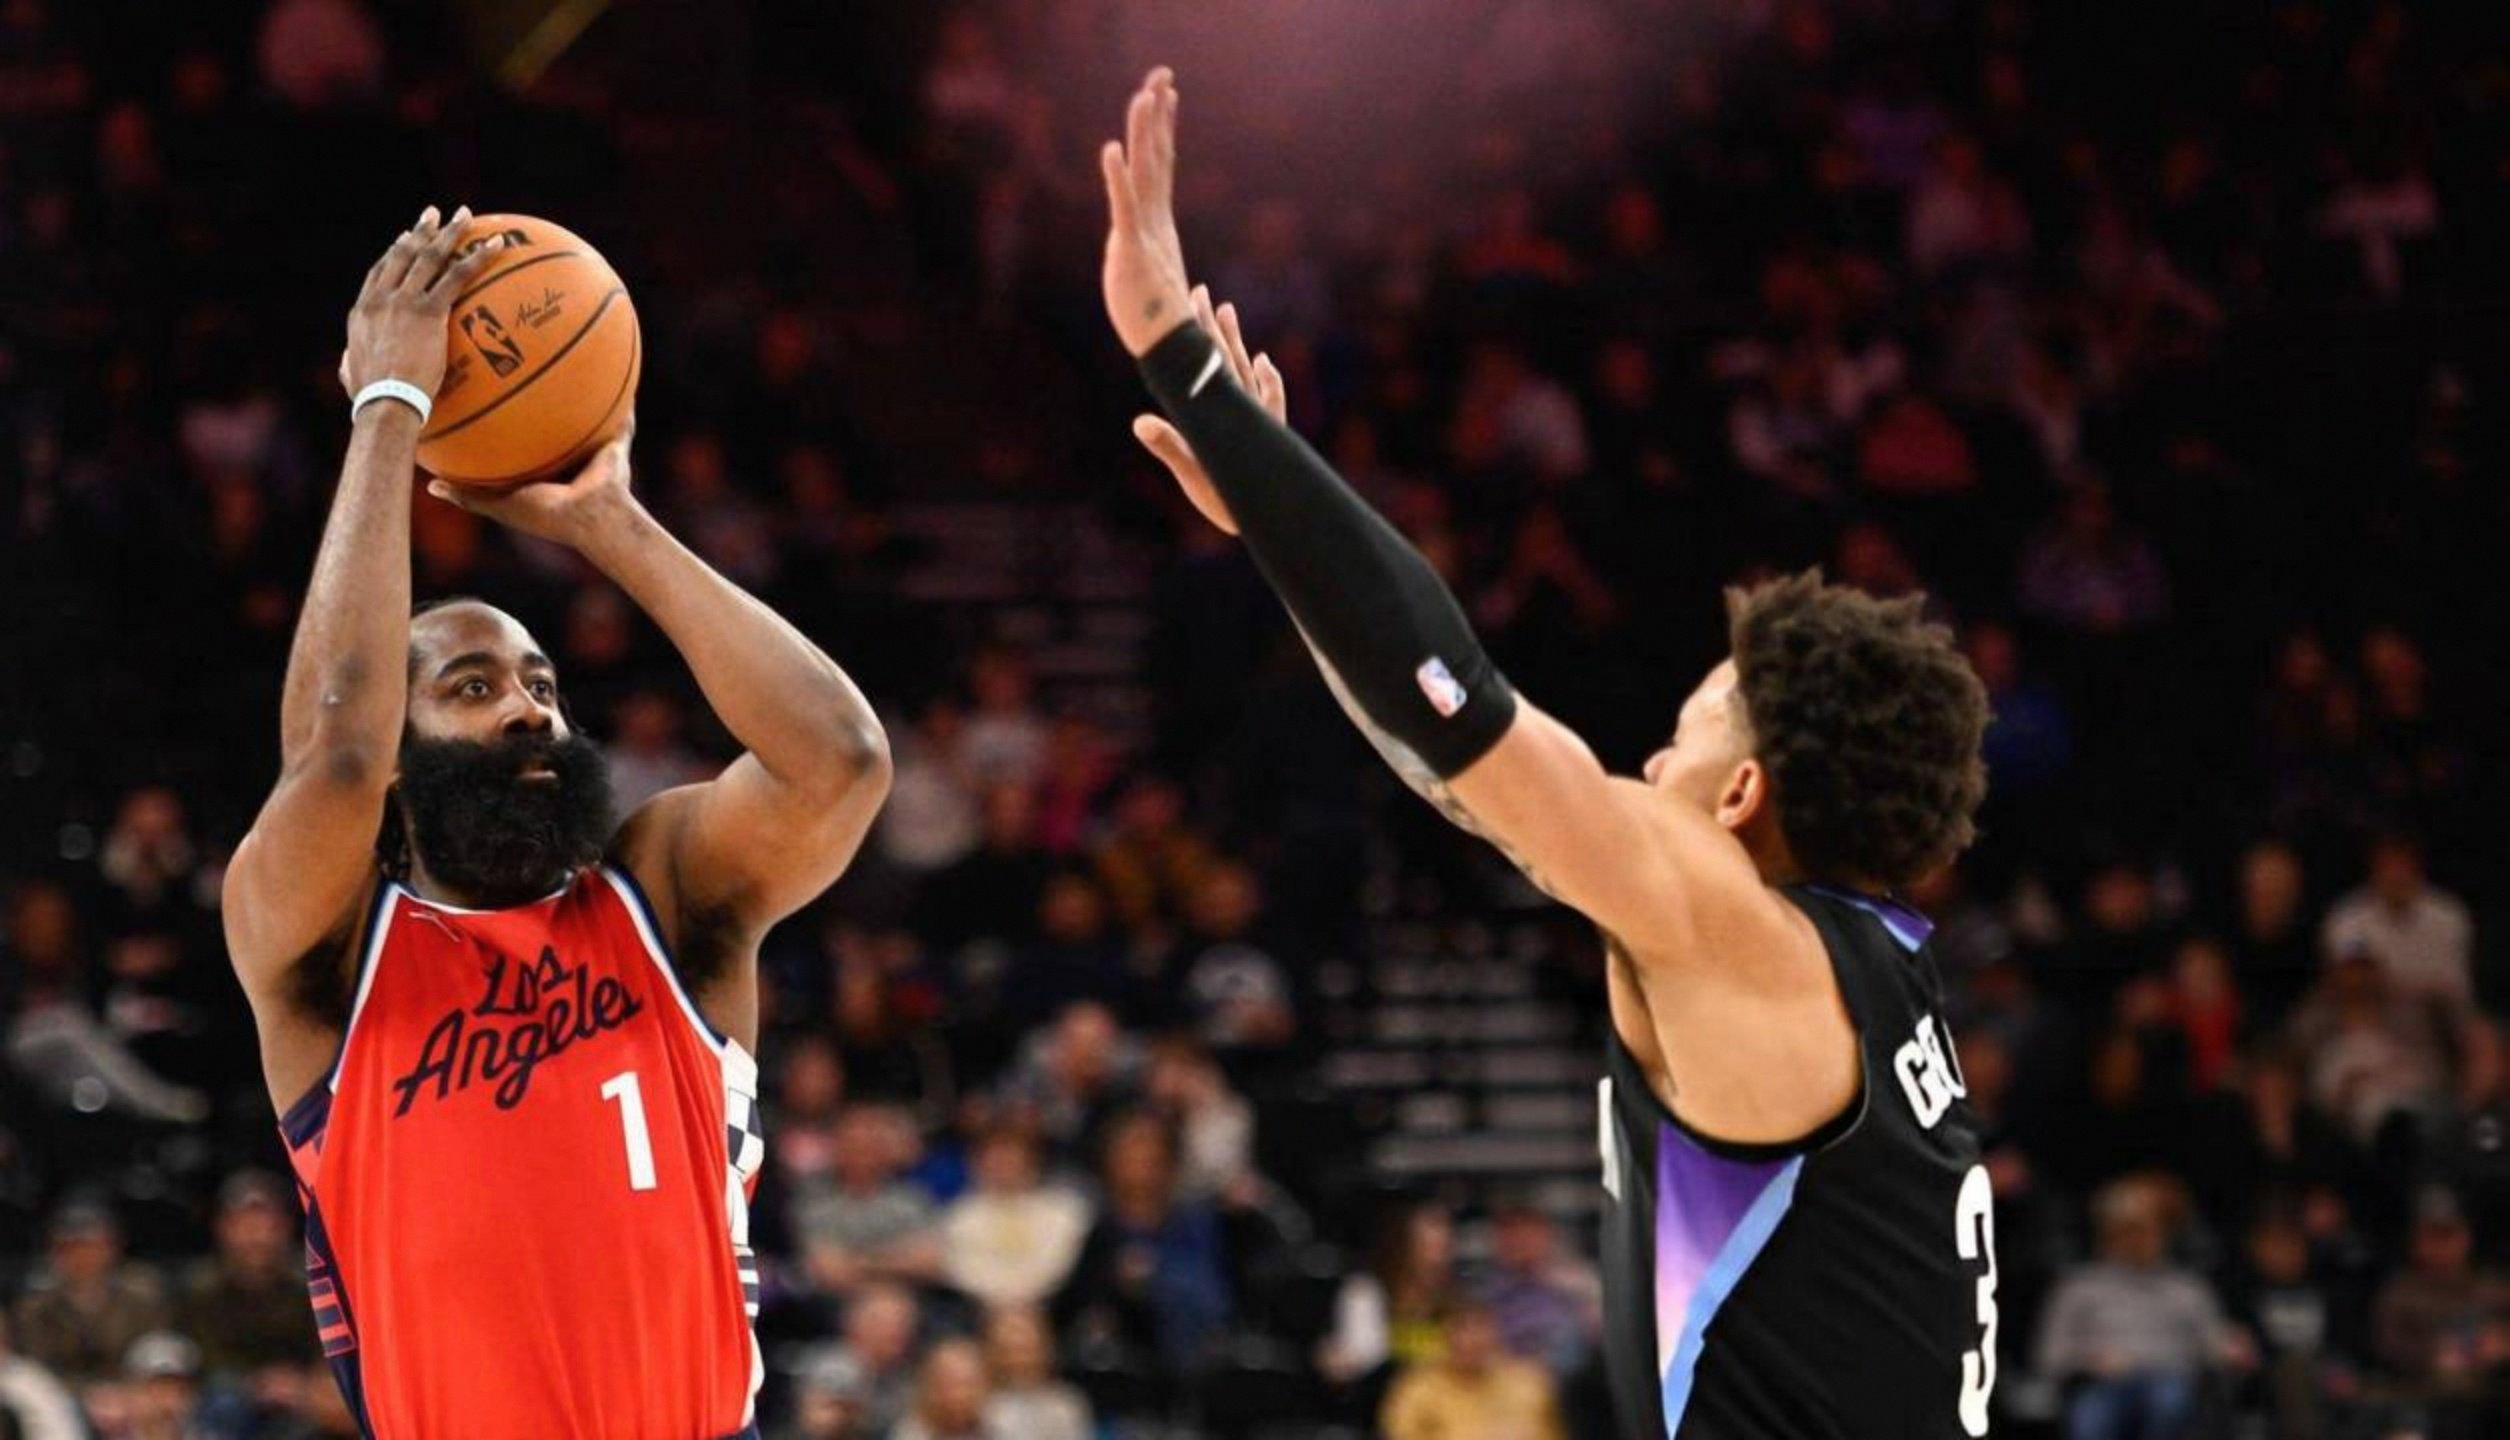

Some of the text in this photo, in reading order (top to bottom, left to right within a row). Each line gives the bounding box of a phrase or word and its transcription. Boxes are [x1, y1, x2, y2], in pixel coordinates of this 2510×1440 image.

[393, 962, 643, 1119] Angeles
[473, 945, 574, 1018] Los
[601, 1071, 657, 1190] 1
[1955, 1164, 1998, 1438] 3
